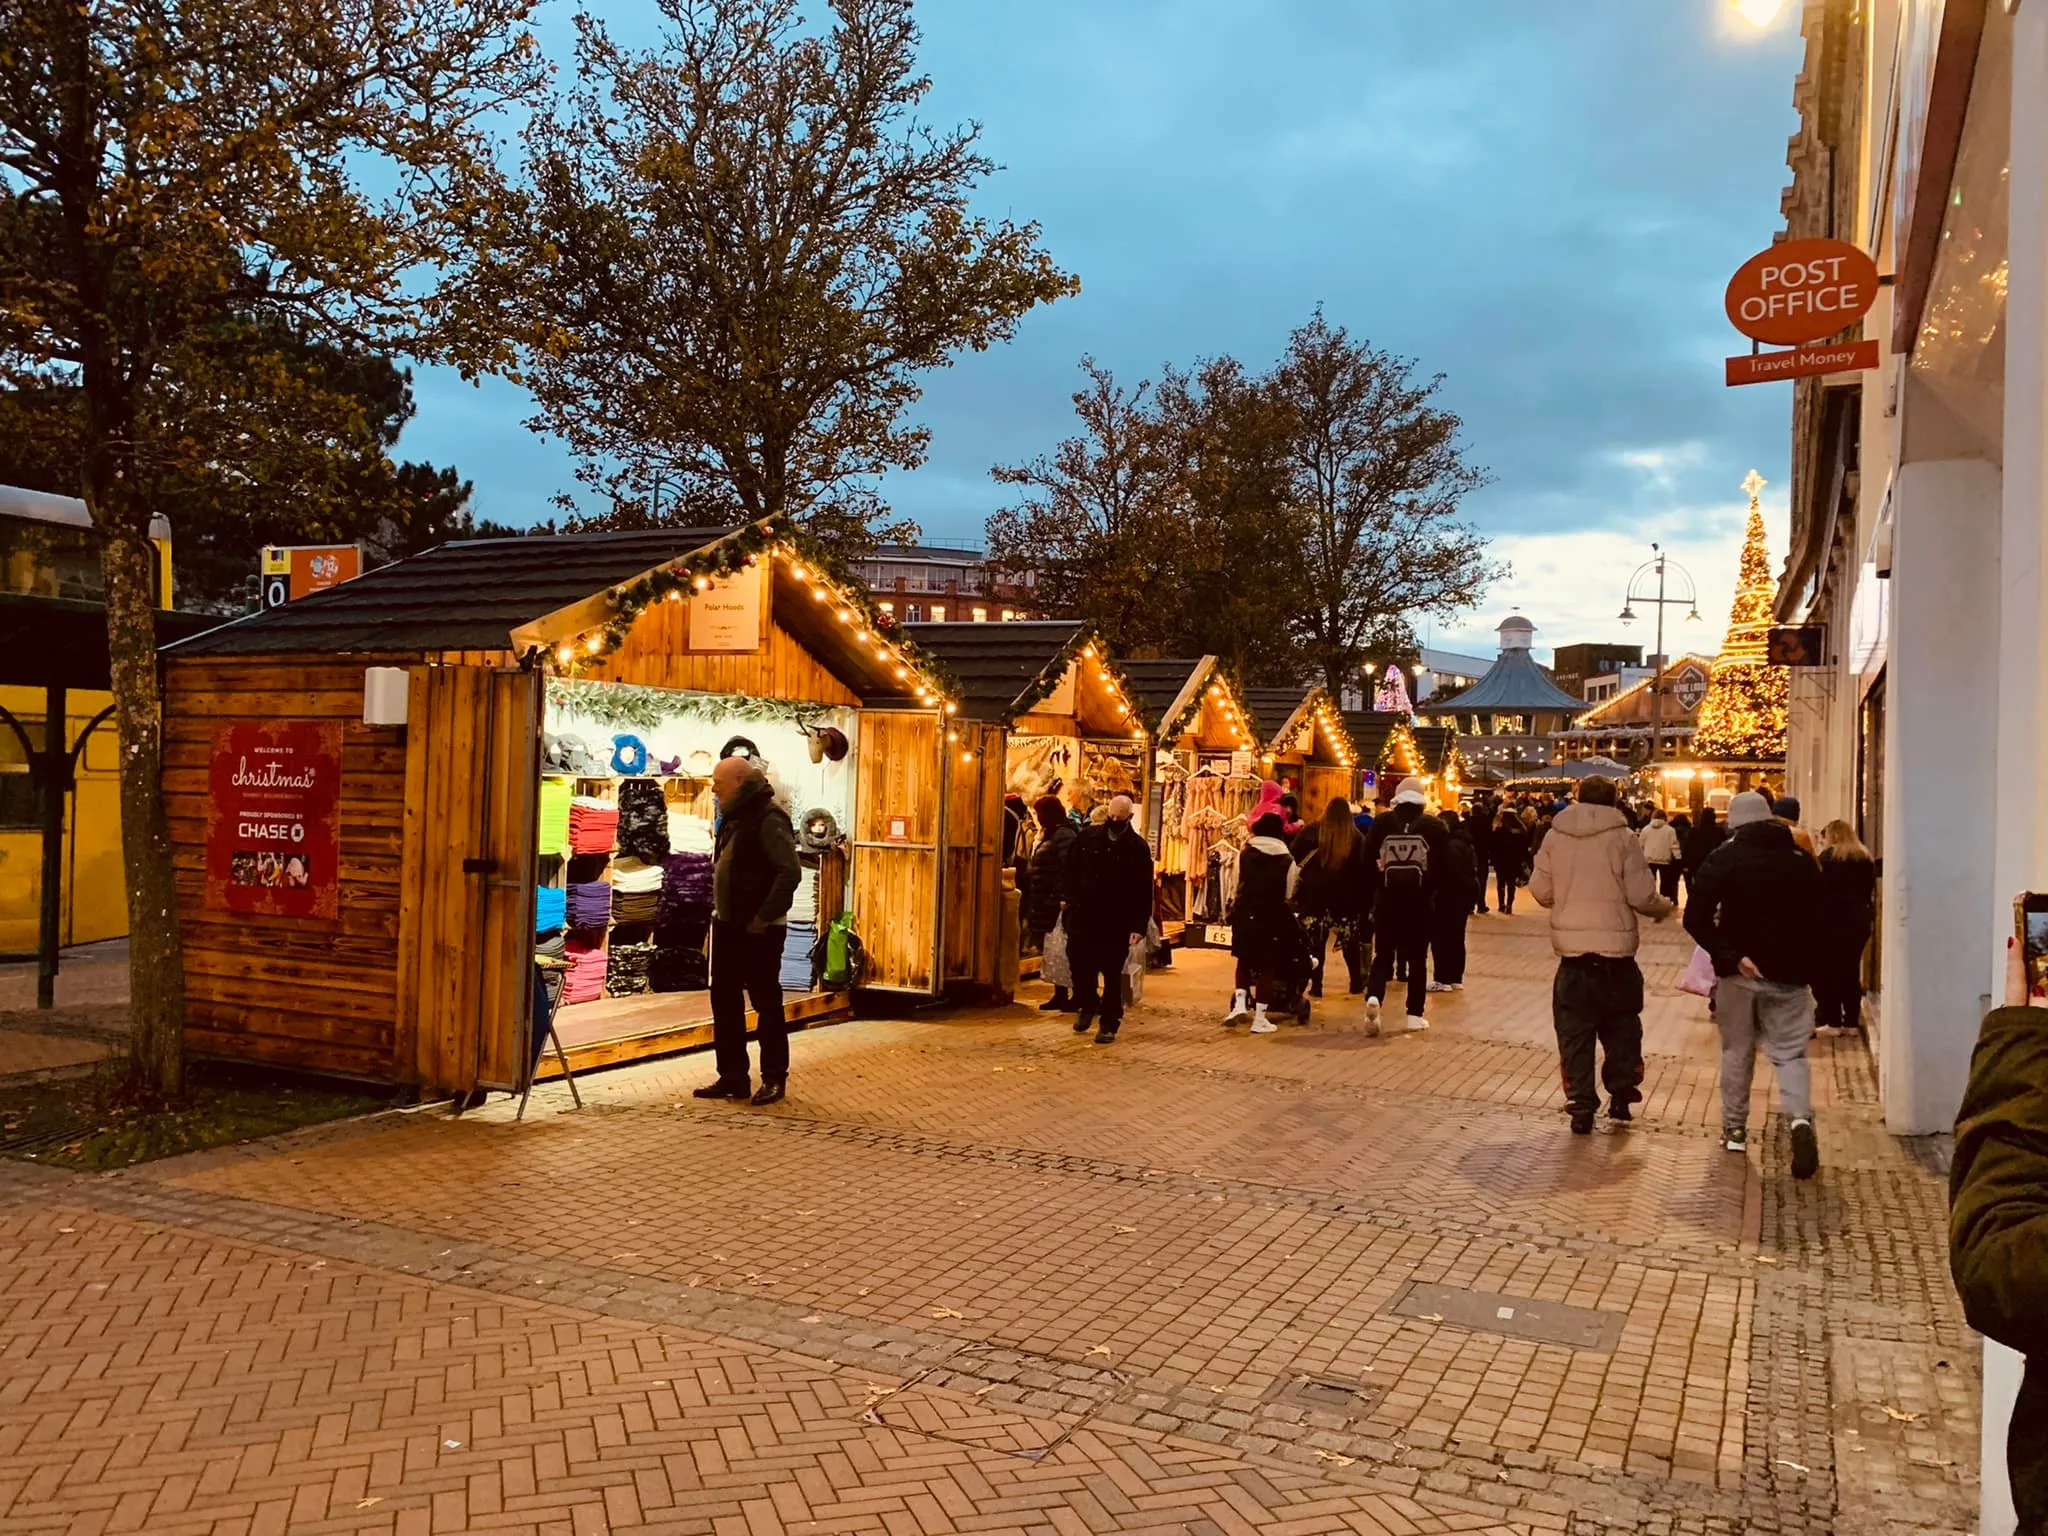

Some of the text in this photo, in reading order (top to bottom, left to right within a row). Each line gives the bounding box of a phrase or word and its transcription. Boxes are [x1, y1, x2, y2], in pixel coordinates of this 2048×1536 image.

[1761, 257, 1847, 291] POST
[1740, 284, 1859, 321] OFFICE
[1751, 351, 1856, 372] Travel Money
[704, 603, 721, 611] Polar
[232, 756, 314, 788] christmas
[239, 823, 289, 840] CHASE
[1213, 932, 1226, 943] £5
